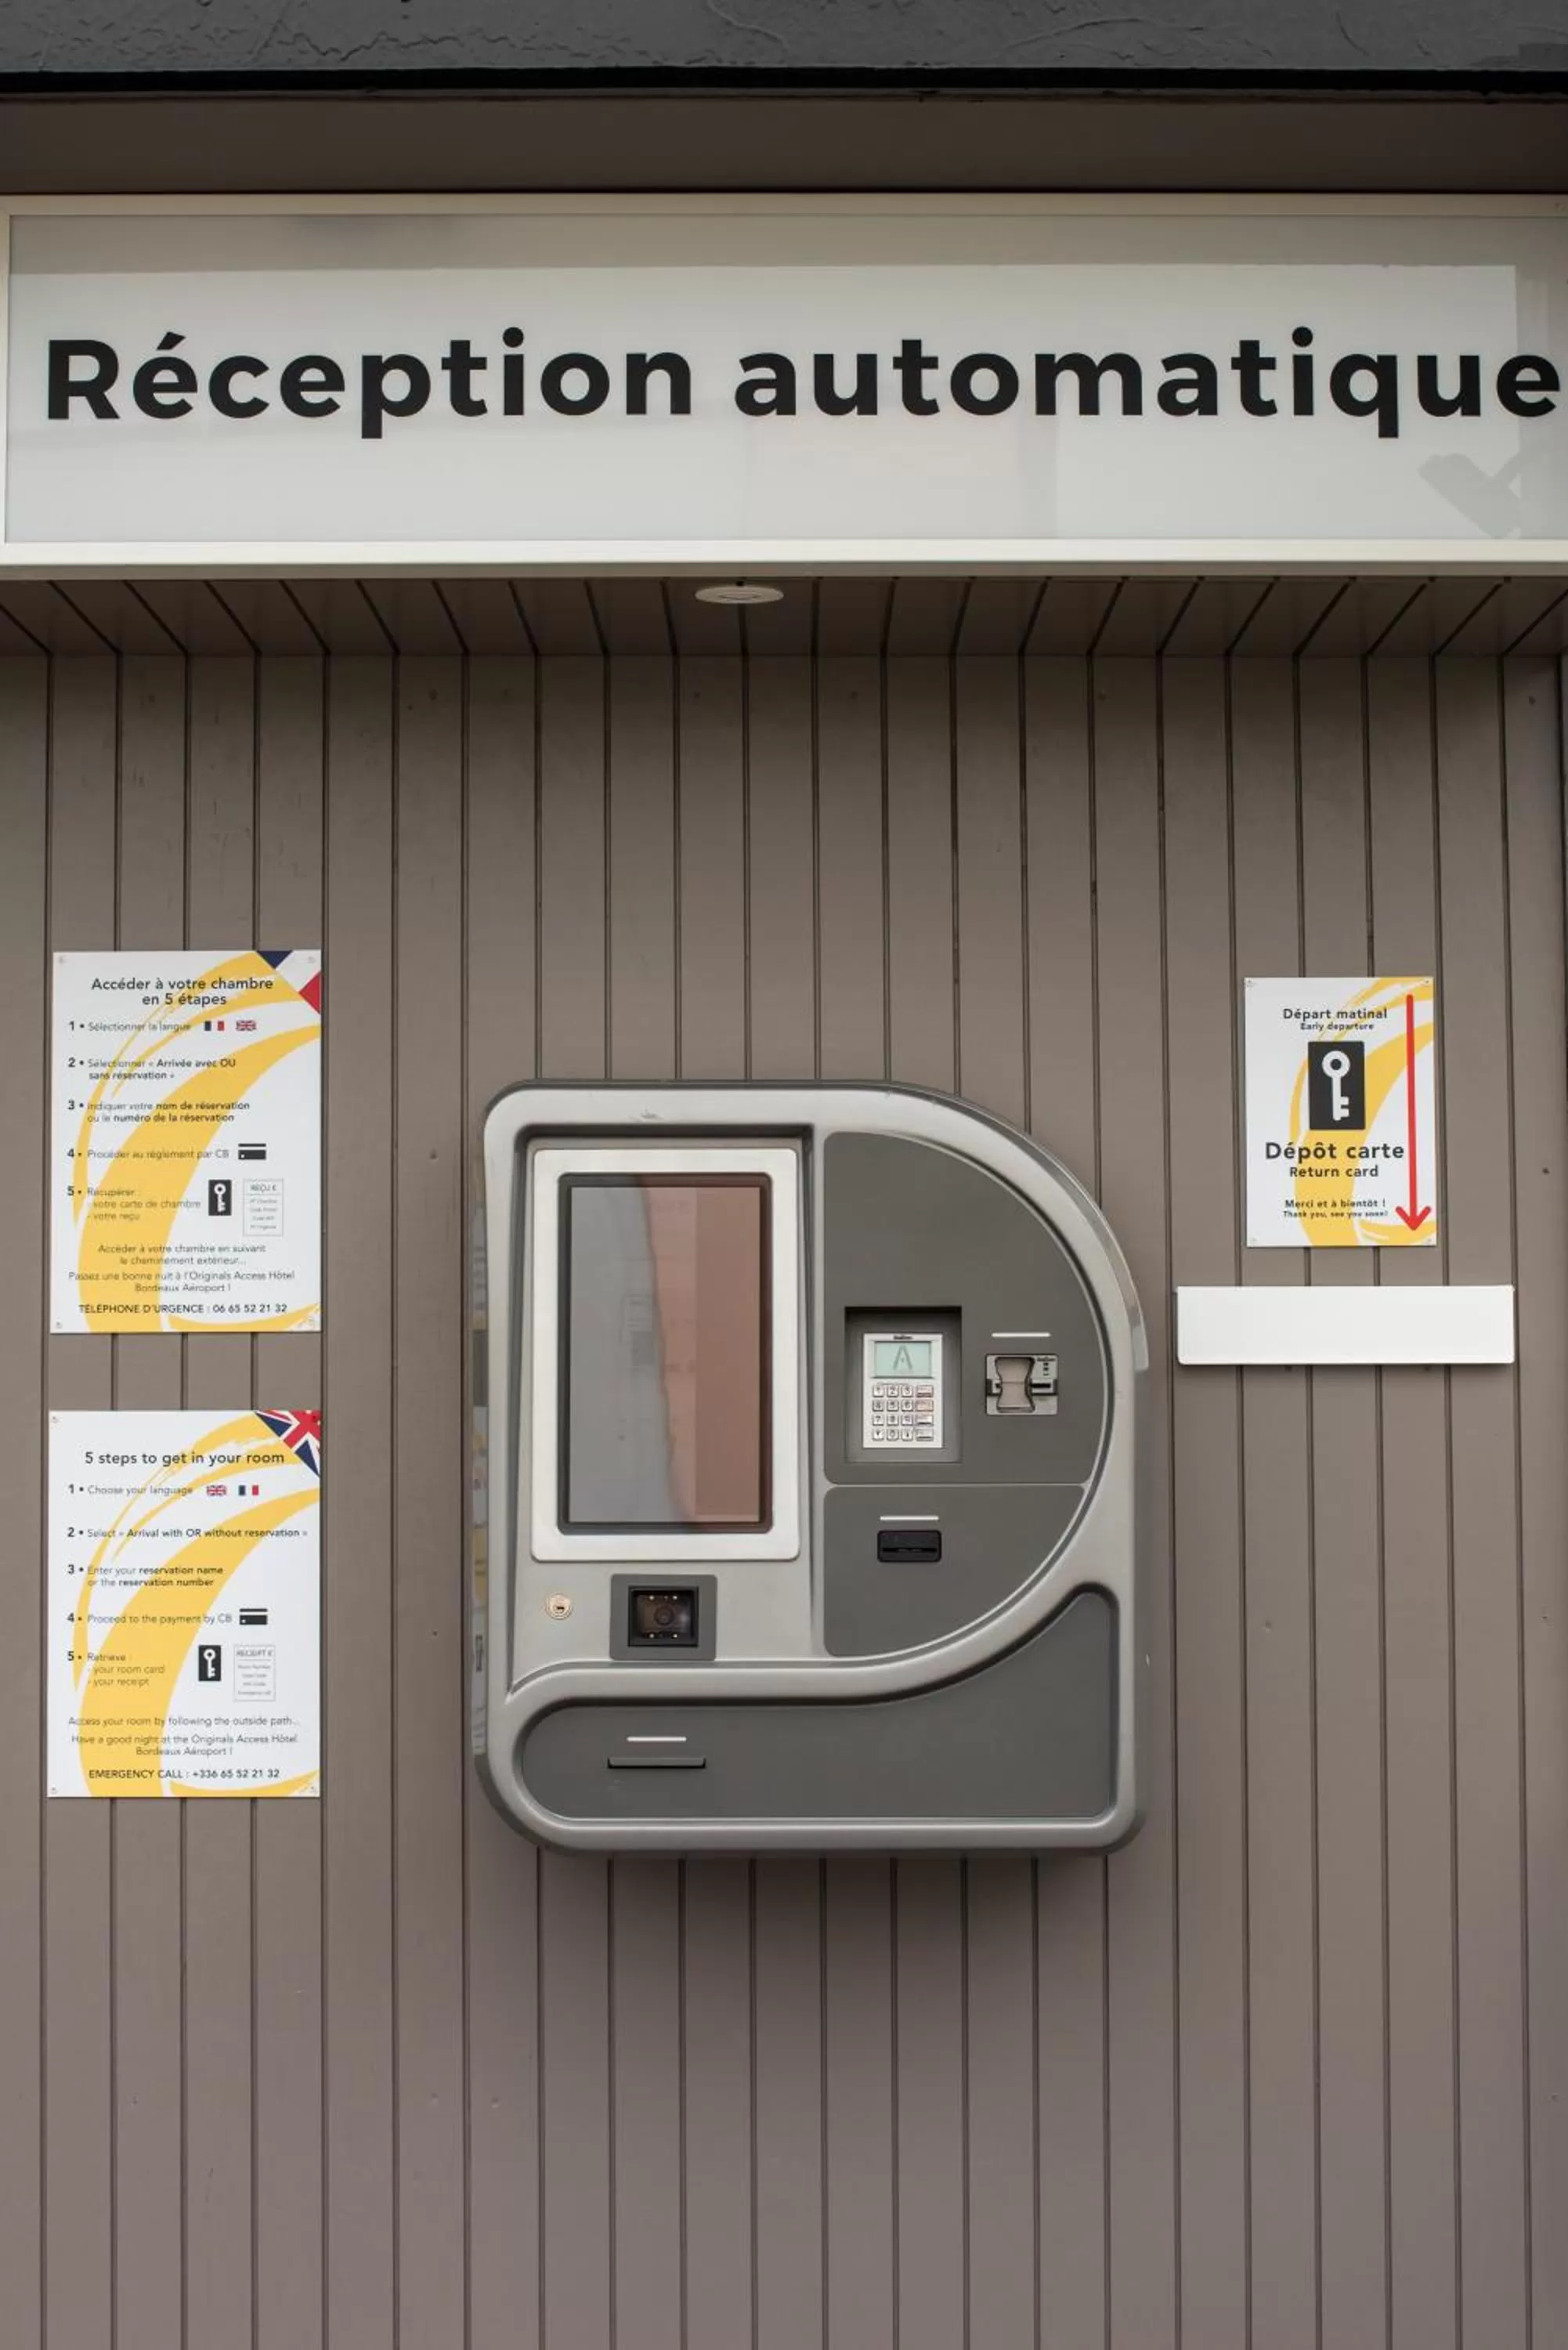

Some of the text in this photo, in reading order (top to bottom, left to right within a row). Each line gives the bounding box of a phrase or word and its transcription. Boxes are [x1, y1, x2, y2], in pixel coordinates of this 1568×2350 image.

[48, 327, 1560, 439] Réception automatique
[92, 978, 273, 989] Accéder à votre chambre
[143, 993, 226, 1007] en 5 étapes
[1283, 1008, 1387, 1021] Départ matinal
[69, 1021, 191, 1033] 1 Sélectionner langue
[1300, 1022, 1374, 1032] Early departure
[68, 1058, 75, 1068] 2
[157, 1058, 192, 1067] Arrivée
[68, 1101, 75, 1110] 3
[87, 1101, 126, 1112] Indiquer
[180, 1101, 193, 1110] de
[196, 1101, 250, 1110] réservation
[114, 1114, 151, 1123] numéro
[67, 1149, 229, 1161] 4 Procéder règlement par CB
[1266, 1142, 1404, 1164] Dépôt carte
[1290, 1166, 1378, 1177] Return card
[67, 1187, 74, 1196] 5
[1285, 1198, 1378, 1208] Merci et à bientôt
[130, 1256, 193, 1265] cheminement
[122, 1271, 152, 1280] bonne
[155, 1271, 172, 1280] nuit
[175, 1271, 181, 1280] à
[234, 1271, 266, 1280] Access
[269, 1271, 294, 1280] Hôtel
[182, 1283, 224, 1293] Aéroport
[213, 1304, 225, 1313] 06
[228, 1304, 240, 1313] 65
[244, 1304, 255, 1313] 52
[259, 1304, 270, 1313] 21
[275, 1304, 287, 1313] 32
[85, 1452, 284, 1466] 5 steps to get in your room
[87, 1486, 123, 1495] Choose
[150, 1485, 193, 1496] language
[67, 1529, 74, 1538] 2
[87, 1529, 116, 1538] Select
[204, 1529, 242, 1538] without
[244, 1529, 299, 1538] reservation
[67, 1565, 74, 1574] 3
[67, 1614, 74, 1622] 4
[87, 1614, 126, 1623] Proceed
[142, 1614, 157, 1623] the
[160, 1616, 201, 1625] payment
[204, 1614, 215, 1625] by
[67, 1652, 125, 1661] 5 Retrieve
[117, 1678, 149, 1687] receipt
[103, 1719, 123, 1727] your
[154, 1717, 165, 1727] by
[168, 1716, 211, 1727] following
[233, 1716, 267, 1725] outside
[107, 1735, 132, 1745] good
[135, 1735, 159, 1745] night
[191, 1735, 233, 1745] Originals
[272, 1734, 298, 1743] Hôtel
[184, 1746, 226, 1757] Aéroport
[193, 1770, 218, 1778] +336
[221, 1770, 233, 1778] 65
[237, 1770, 248, 1778] 52
[252, 1770, 263, 1778] 21
[268, 1770, 280, 1778] 32
